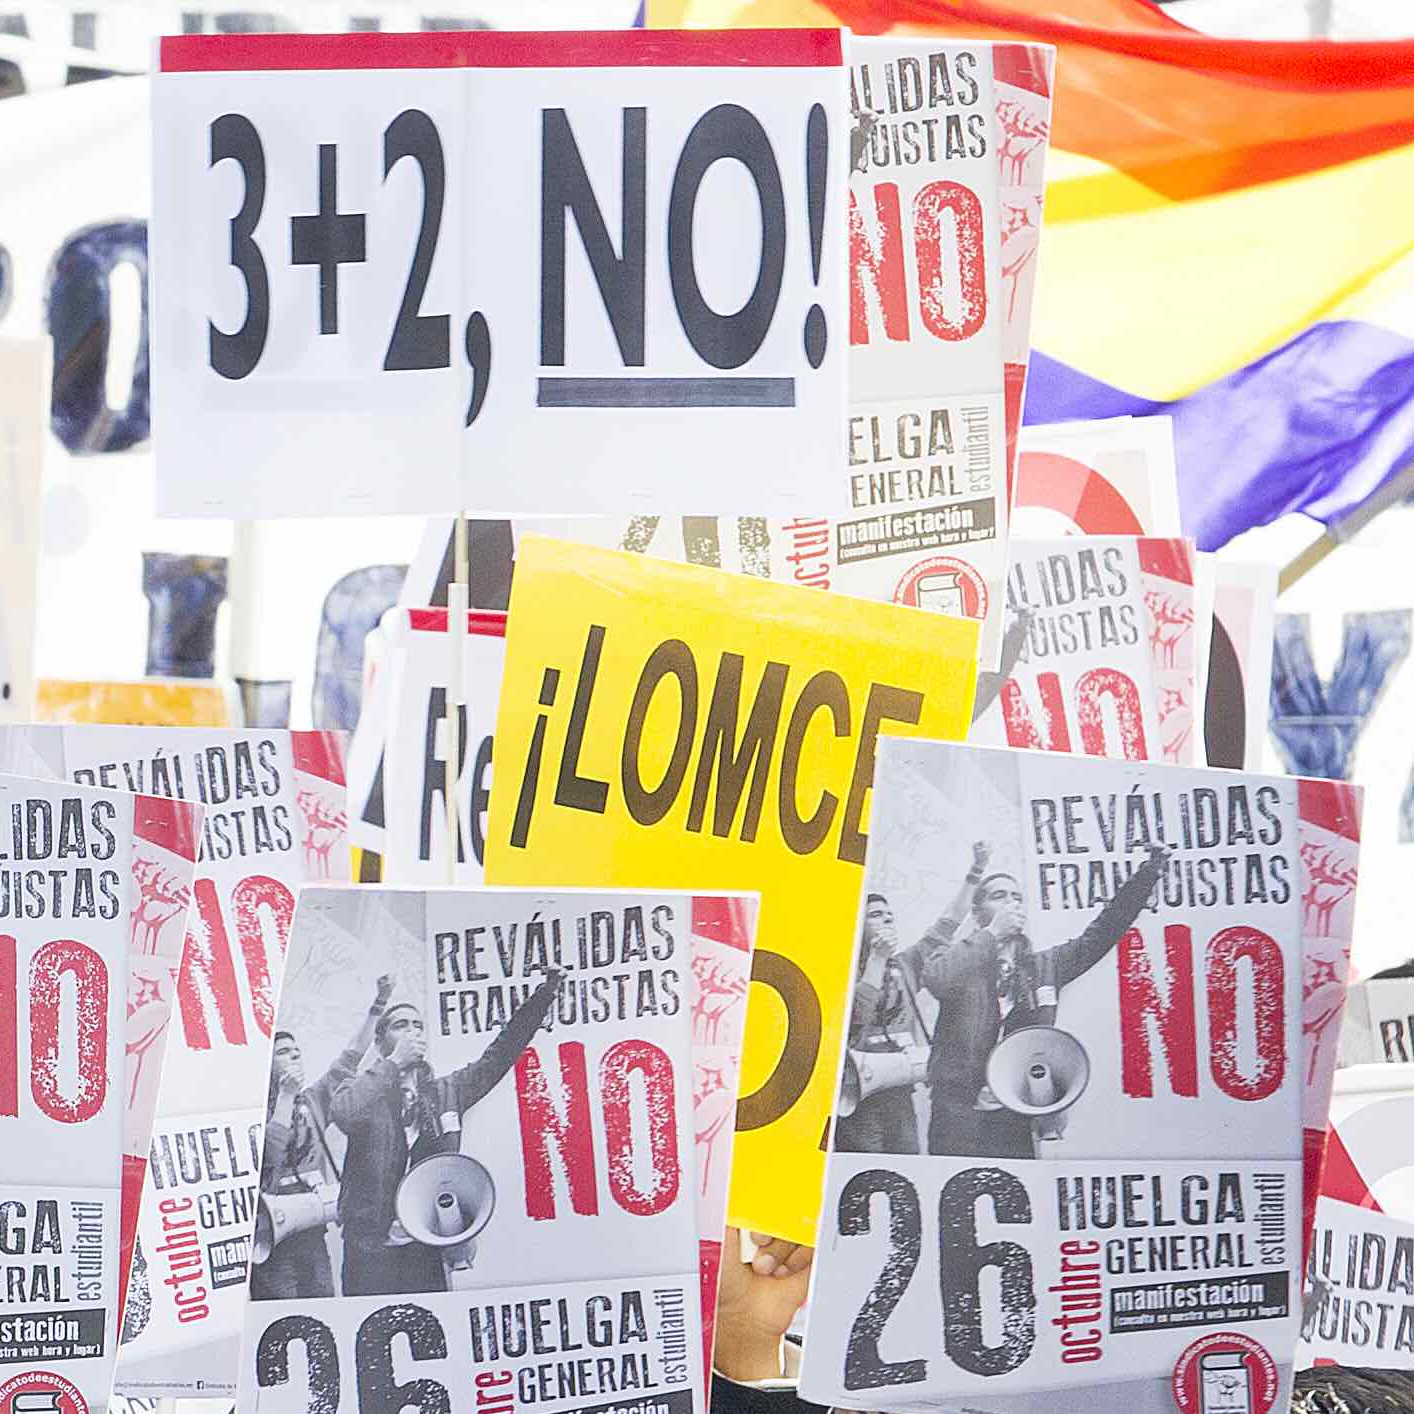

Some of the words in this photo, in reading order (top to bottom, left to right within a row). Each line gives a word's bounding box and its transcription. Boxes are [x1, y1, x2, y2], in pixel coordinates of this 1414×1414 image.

[849, 51, 978, 116] LIDAS
[209, 109, 491, 428] 3+2,
[539, 103, 828, 369] NO!
[849, 181, 987, 346] NO
[962, 406, 990, 493] estudiantil
[839, 505, 974, 546] manifestación
[510, 624, 923, 866] ¡LOMCE
[1031, 785, 1282, 854] REVÁLIDAS
[176, 875, 295, 1051] NO
[435, 905, 676, 983] REVÁLIDAS
[1117, 926, 1285, 1101] NO
[517, 1040, 679, 1219] NO
[71, 1201, 103, 1302] estudiantil
[156, 1196, 210, 1323] octubre
[838, 1168, 1036, 1391] 26
[1056, 1172, 1245, 1230] HUELGA
[1252, 1172, 1285, 1266] estudiantil
[1049, 1239, 1102, 1364] octubre
[1105, 1232, 1252, 1274] GENERAL
[1115, 1279, 1265, 1312] manifestación
[470, 1290, 648, 1363] HUELGA
[654, 1288, 688, 1384] estudiantil
[518, 1352, 659, 1403] GENERAL
